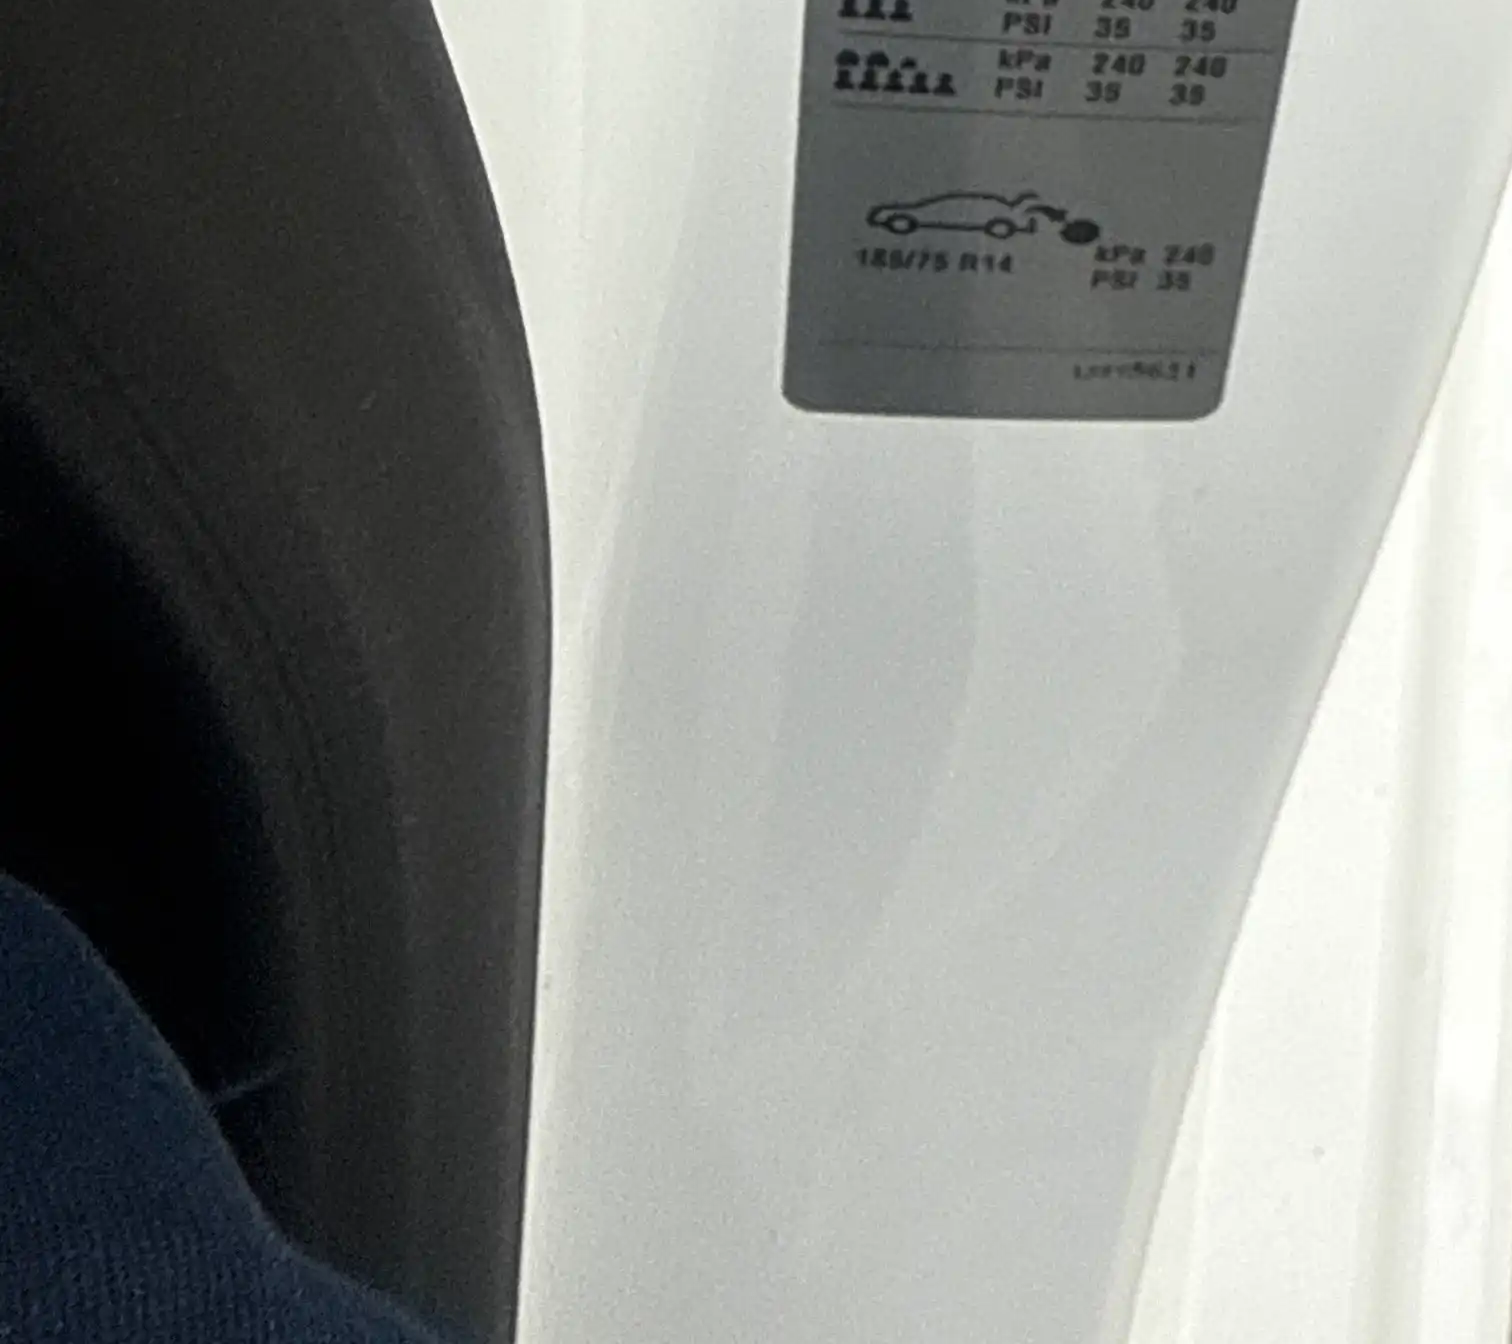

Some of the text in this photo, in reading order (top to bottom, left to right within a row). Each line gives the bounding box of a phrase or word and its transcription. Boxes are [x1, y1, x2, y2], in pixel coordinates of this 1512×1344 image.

[1002, 11, 1216, 43] PSI 35 35
[1092, 52, 1146, 76] 240
[1174, 55, 1228, 79] 240
[994, 76, 1206, 107] PSI 35 35
